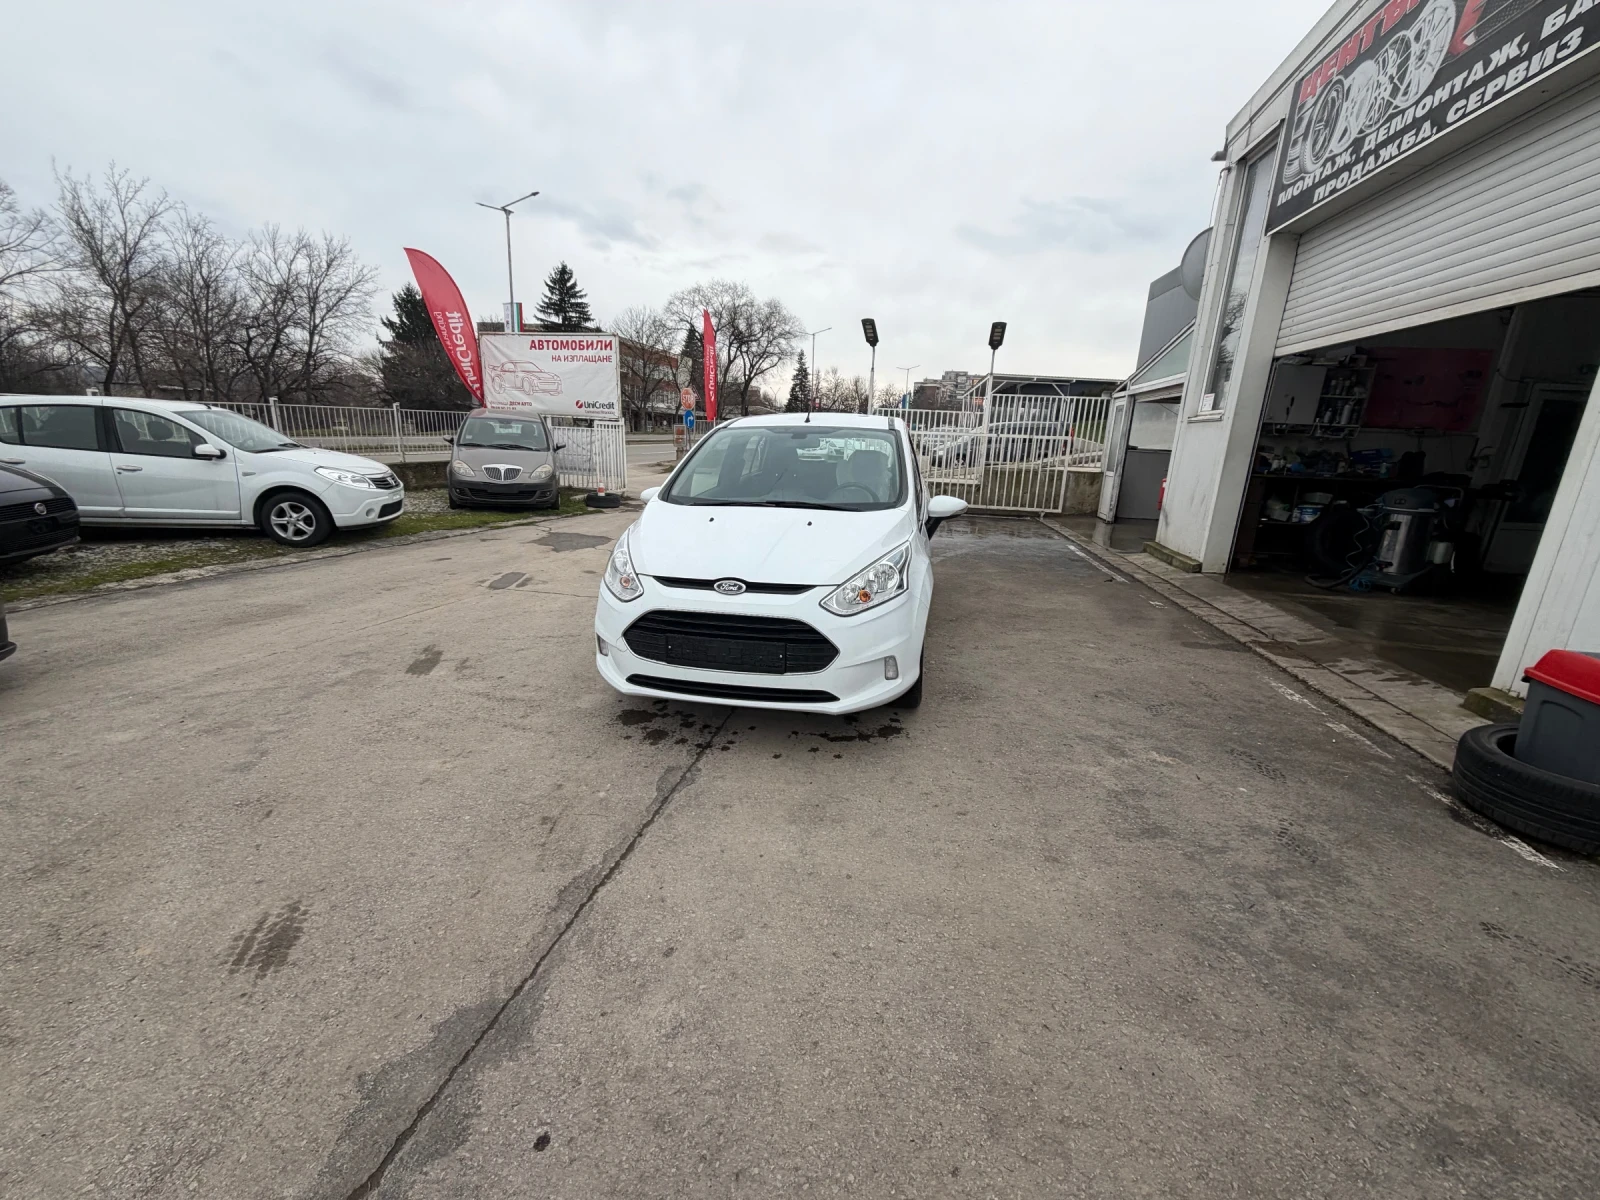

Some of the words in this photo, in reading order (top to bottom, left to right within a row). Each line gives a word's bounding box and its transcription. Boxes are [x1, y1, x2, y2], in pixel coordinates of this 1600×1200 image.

[1298, 0, 1420, 106] ЦЕНТЪ
[1277, 147, 1356, 207] МОНТАЖ,
[1540, 0, 1600, 41] БА
[1312, 120, 1438, 204] ПРОДАЖБА,
[1446, 26, 1585, 123] СЕРВИЗ
[529, 339, 613, 351] АВТОМОБИЛИ
[551, 354, 562, 363] НА
[563, 354, 613, 364] ИЗПЛАЩАНЕ
[583, 400, 616, 410] UniCredit
